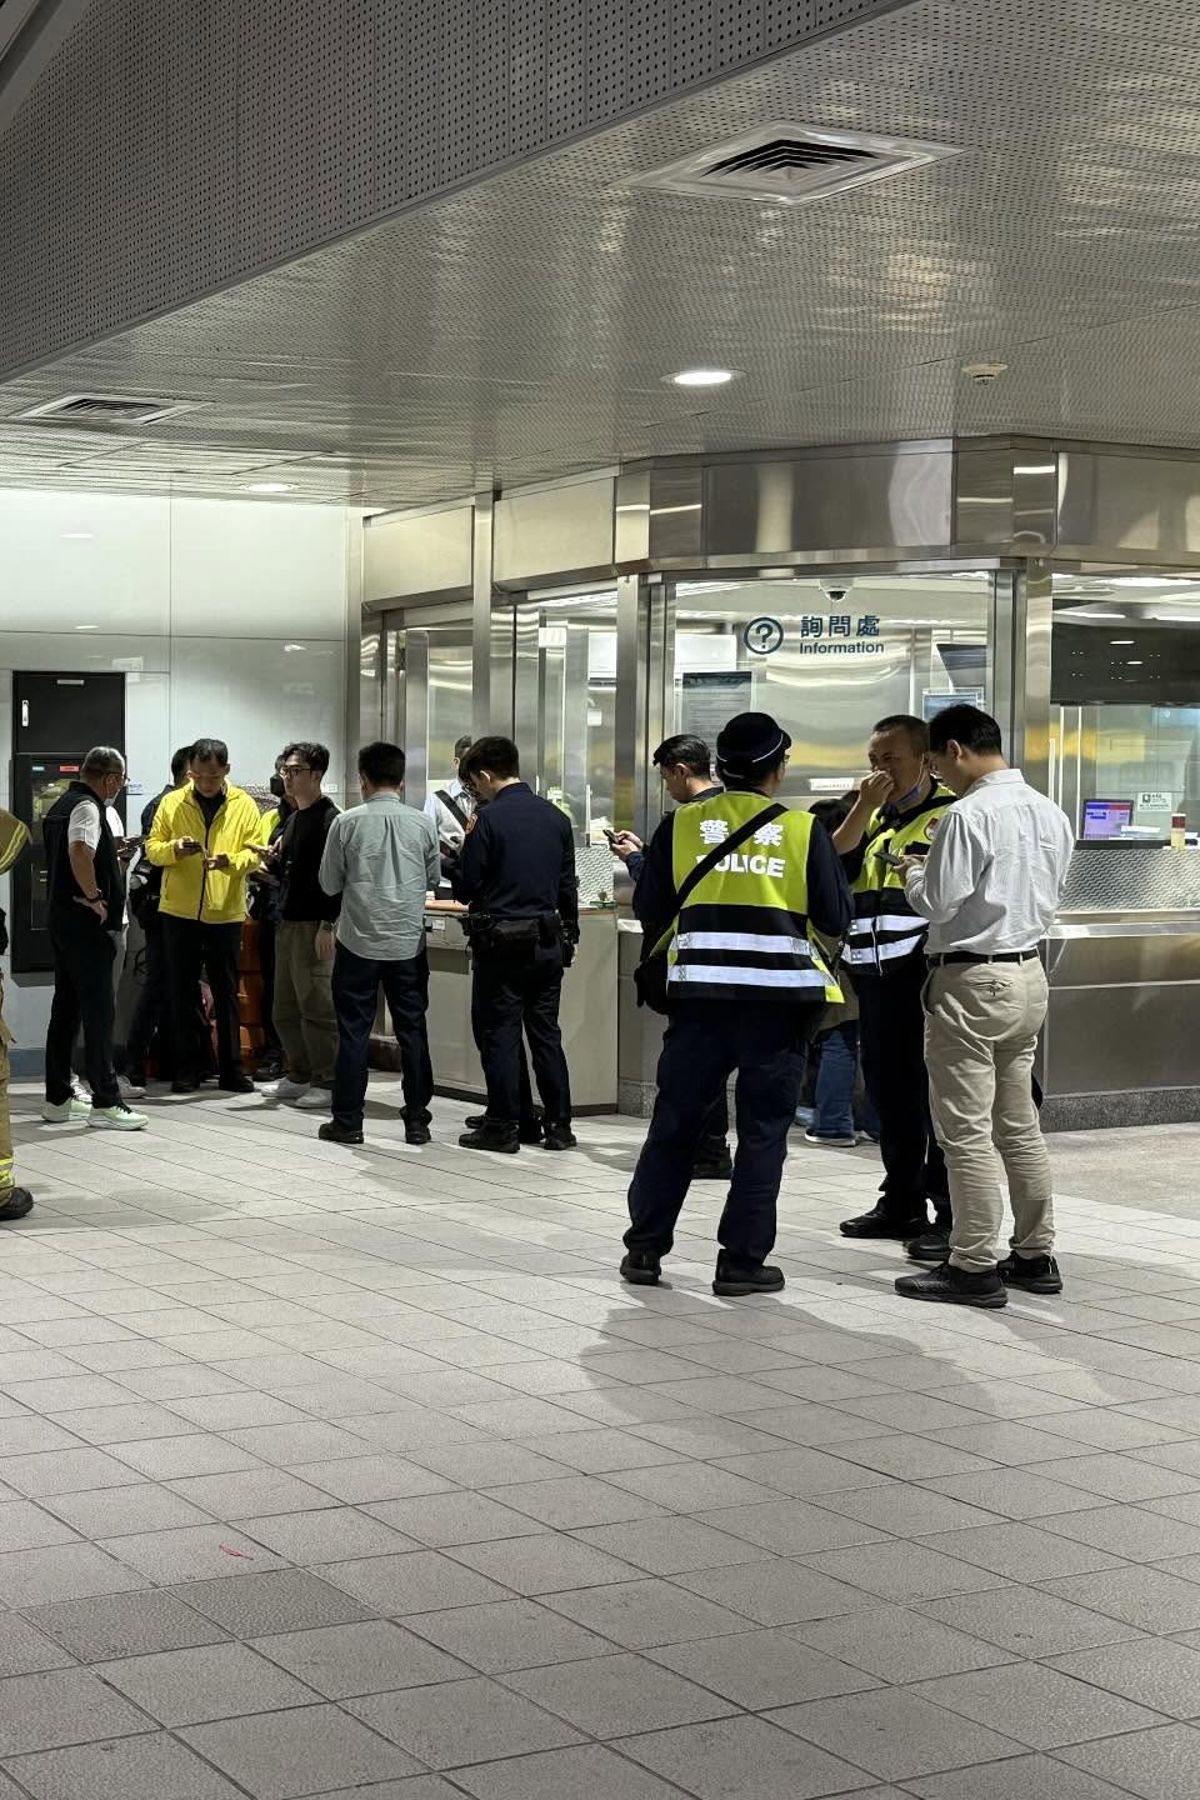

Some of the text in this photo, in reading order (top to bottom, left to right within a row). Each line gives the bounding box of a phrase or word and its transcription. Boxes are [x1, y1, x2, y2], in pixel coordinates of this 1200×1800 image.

[800, 615, 880, 638] 詢問處
[800, 641, 885, 655] Information
[700, 819, 784, 847] 警察
[696, 853, 786, 878] OLICE
